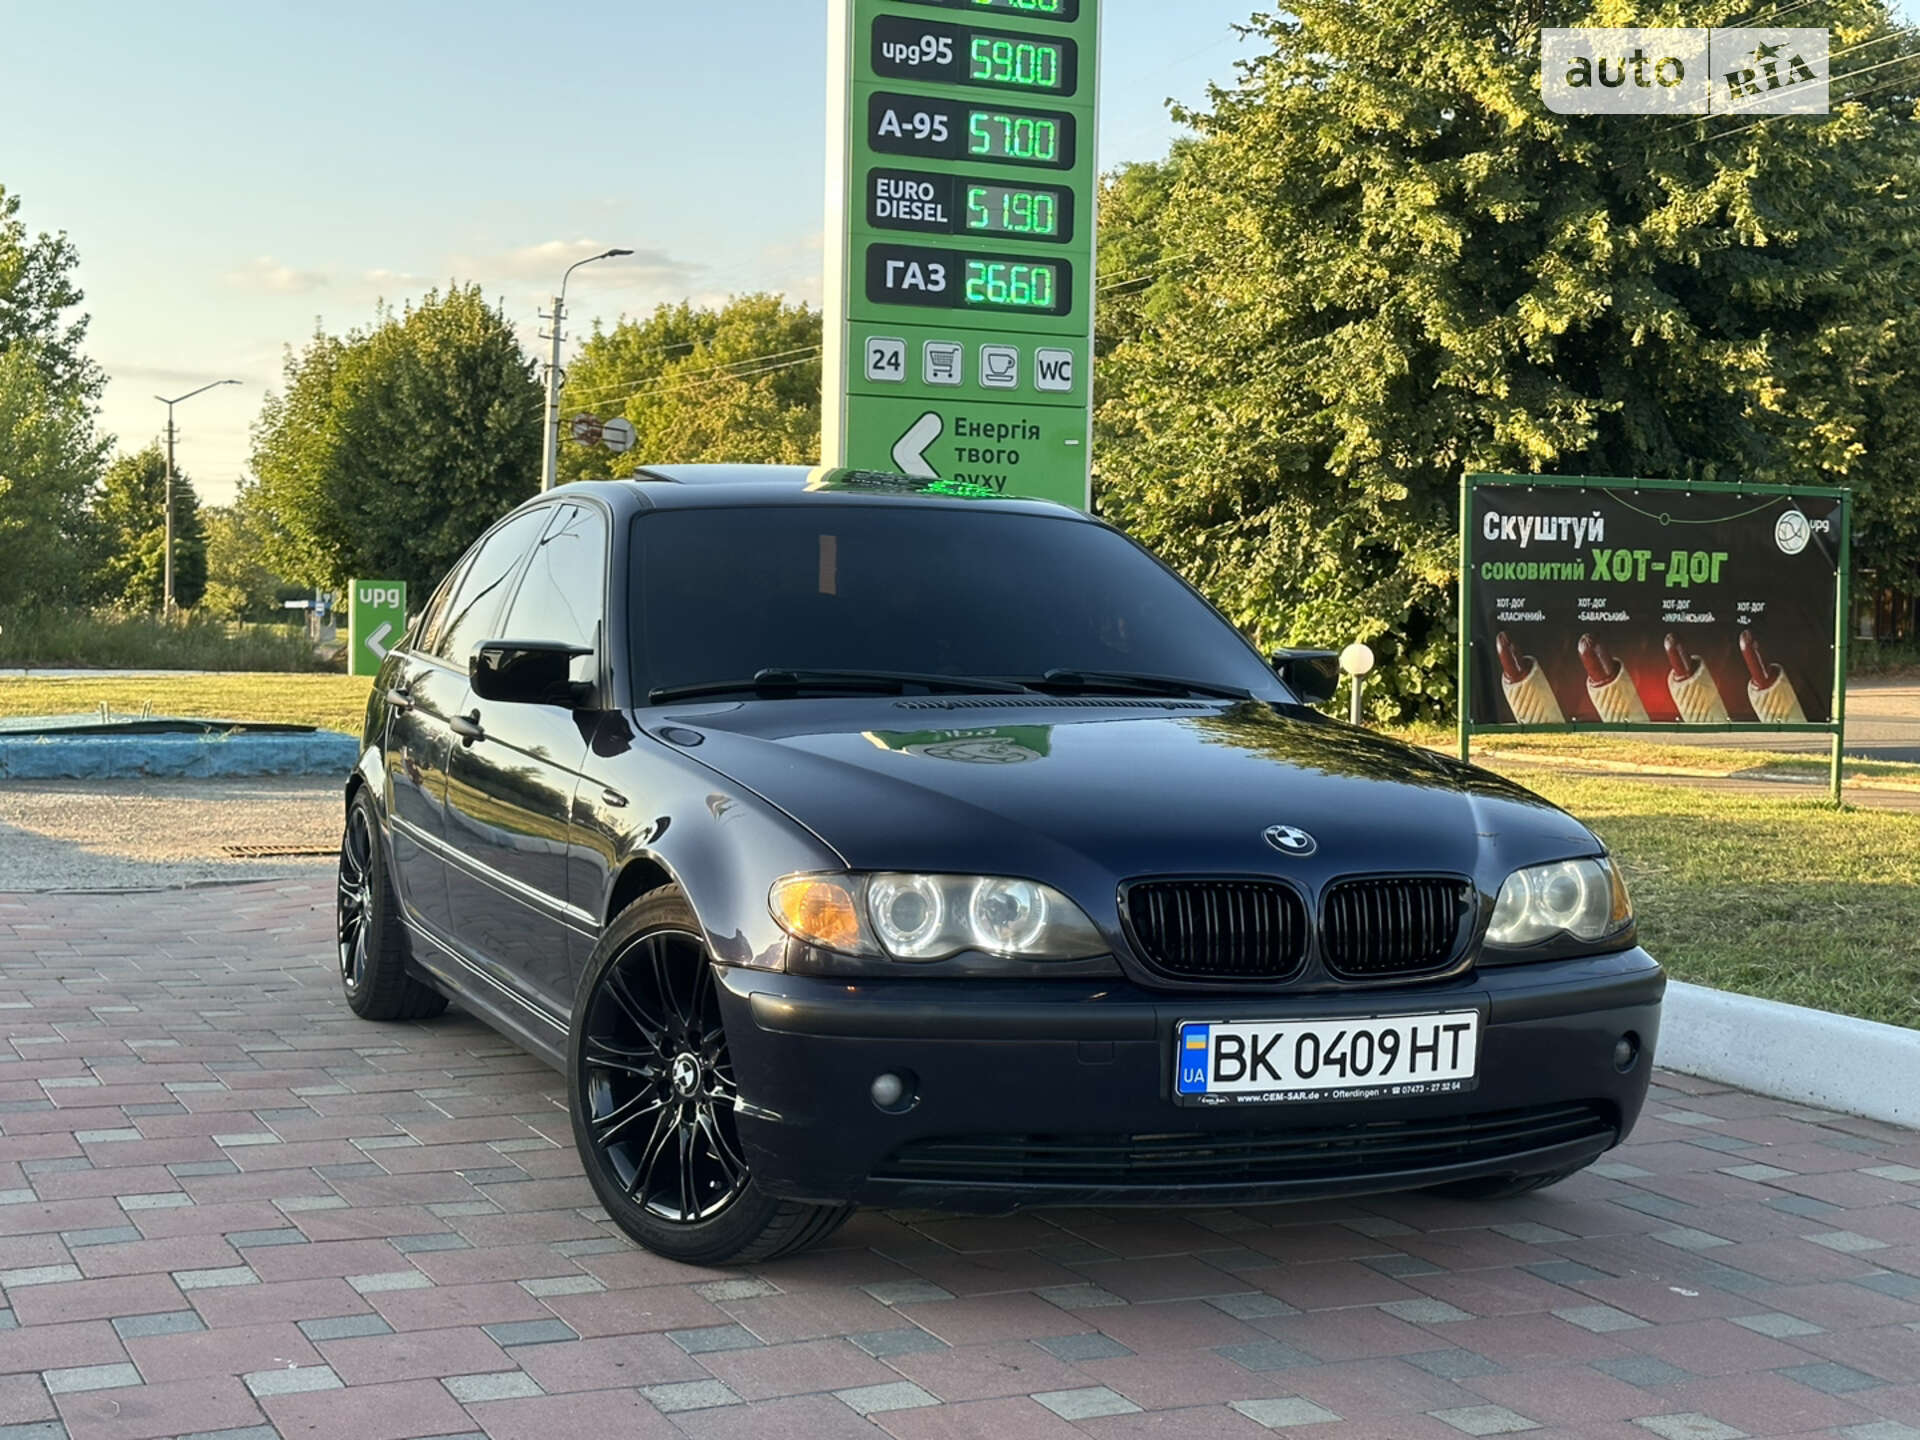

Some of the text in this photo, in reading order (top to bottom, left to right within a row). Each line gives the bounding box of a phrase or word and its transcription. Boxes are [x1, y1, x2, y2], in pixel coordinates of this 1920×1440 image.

[882, 35, 953, 65] upg95
[878, 109, 949, 142] A-95
[876, 178, 935, 201] EURO
[875, 199, 948, 223] DIESEL
[968, 188, 1053, 233] 51.90
[885, 260, 946, 292] ГАЗ
[966, 262, 1051, 306] 26.60
[872, 349, 901, 372] 24
[1039, 360, 1071, 382] WC
[954, 417, 1040, 442] Енергія
[954, 447, 1020, 465] твого
[1483, 511, 1605, 549] Скуштуй
[1810, 519, 1830, 533] upg
[1481, 548, 1729, 588] соковитий ХОТ-ДОГ
[360, 588, 400, 608] upg
[1213, 1023, 1471, 1082] BK 0409 HT
[1183, 1068, 1205, 1083] UA
[1332, 1088, 1380, 1099] Ofterdingen
